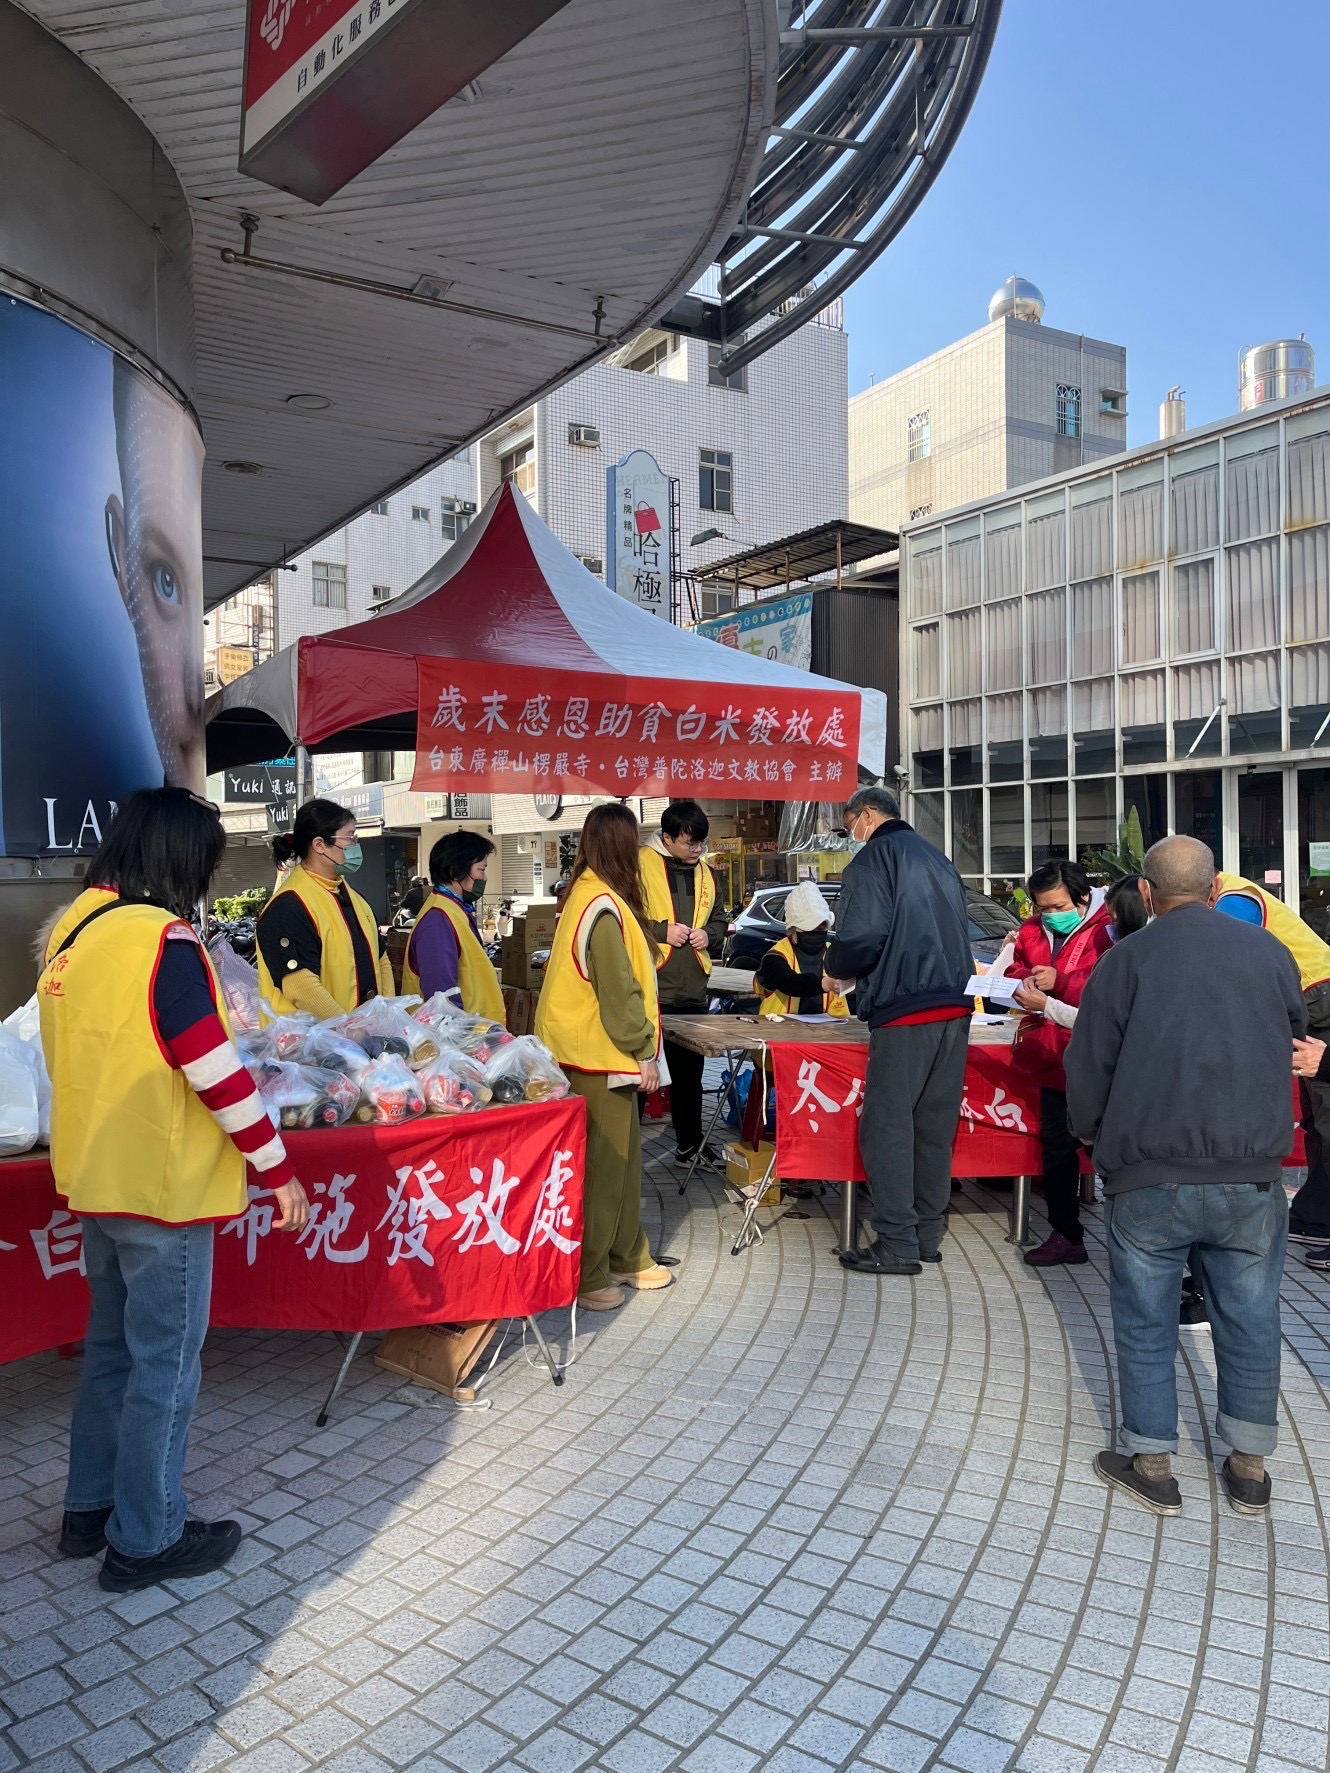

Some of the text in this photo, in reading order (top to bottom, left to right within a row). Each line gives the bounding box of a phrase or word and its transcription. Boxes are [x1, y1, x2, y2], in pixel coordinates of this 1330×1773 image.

[623, 487, 633, 549] 名牌精品
[430, 684, 847, 747] 歲末感恩助貧白米發放處
[808, 759, 843, 783] 主辦
[231, 777, 264, 794] Yuki
[269, 806, 289, 824] Yuki
